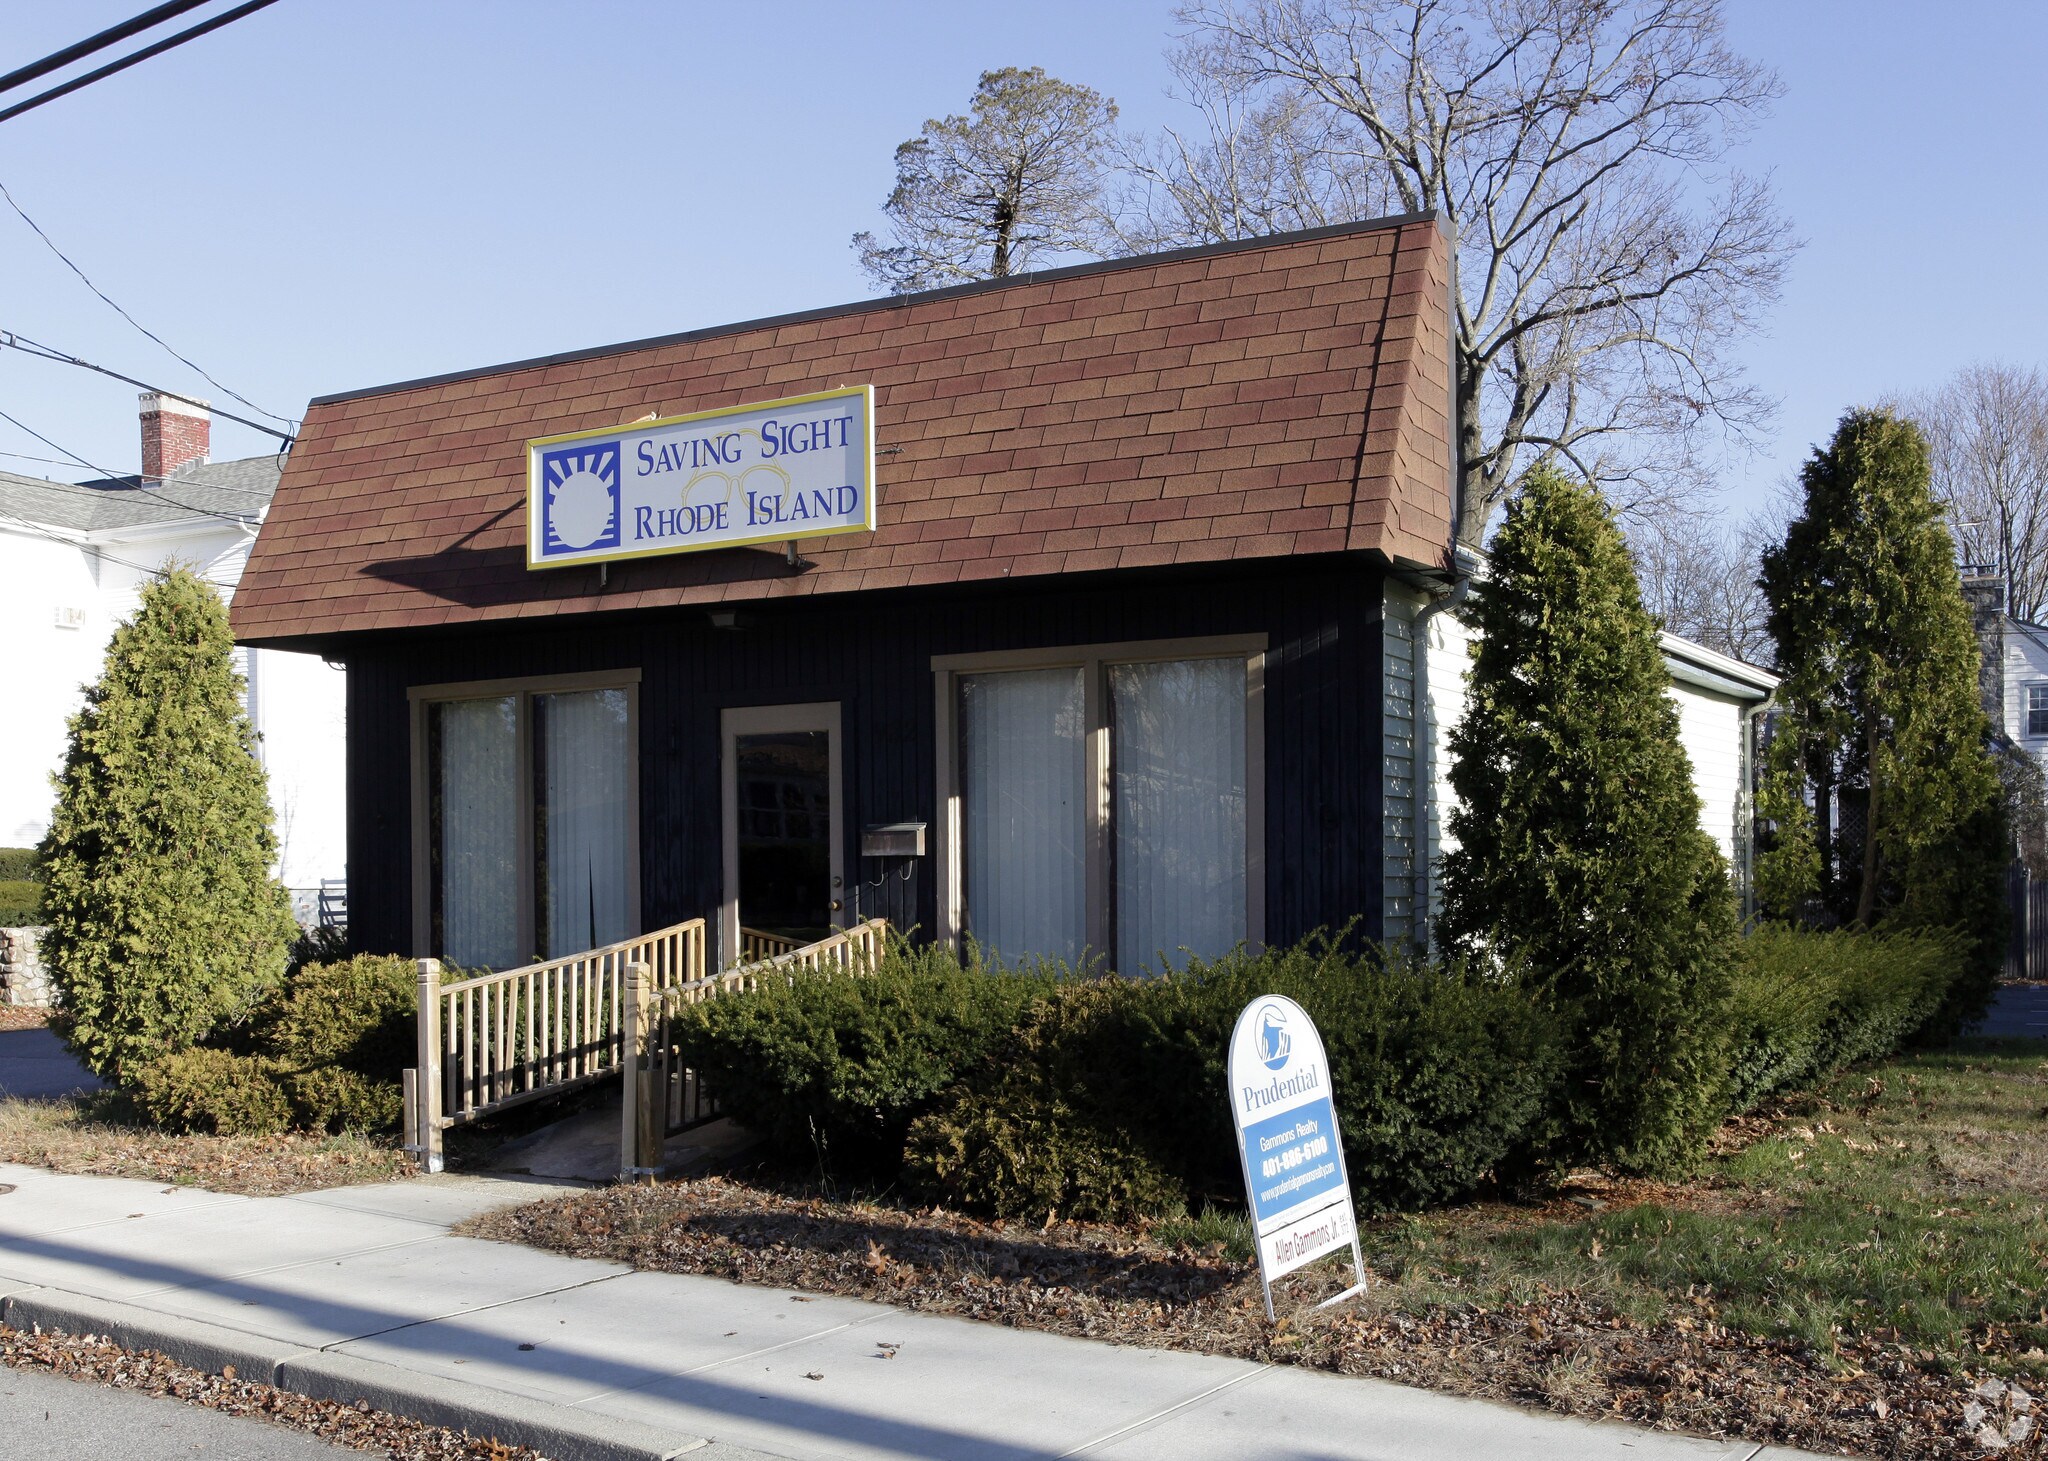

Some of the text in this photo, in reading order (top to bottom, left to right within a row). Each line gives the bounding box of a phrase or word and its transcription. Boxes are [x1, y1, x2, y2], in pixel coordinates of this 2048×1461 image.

[637, 416, 853, 477] SAVING SIGHT
[634, 485, 858, 540] RHODE ISLAND
[1242, 1064, 1319, 1112] Prudential
[1260, 1119, 1318, 1152] Gammons Realty
[1263, 1136, 1328, 1178] 401-886-6100
[1275, 1238, 1295, 1266] Allen
[1293, 1224, 1330, 1257] Gammons
